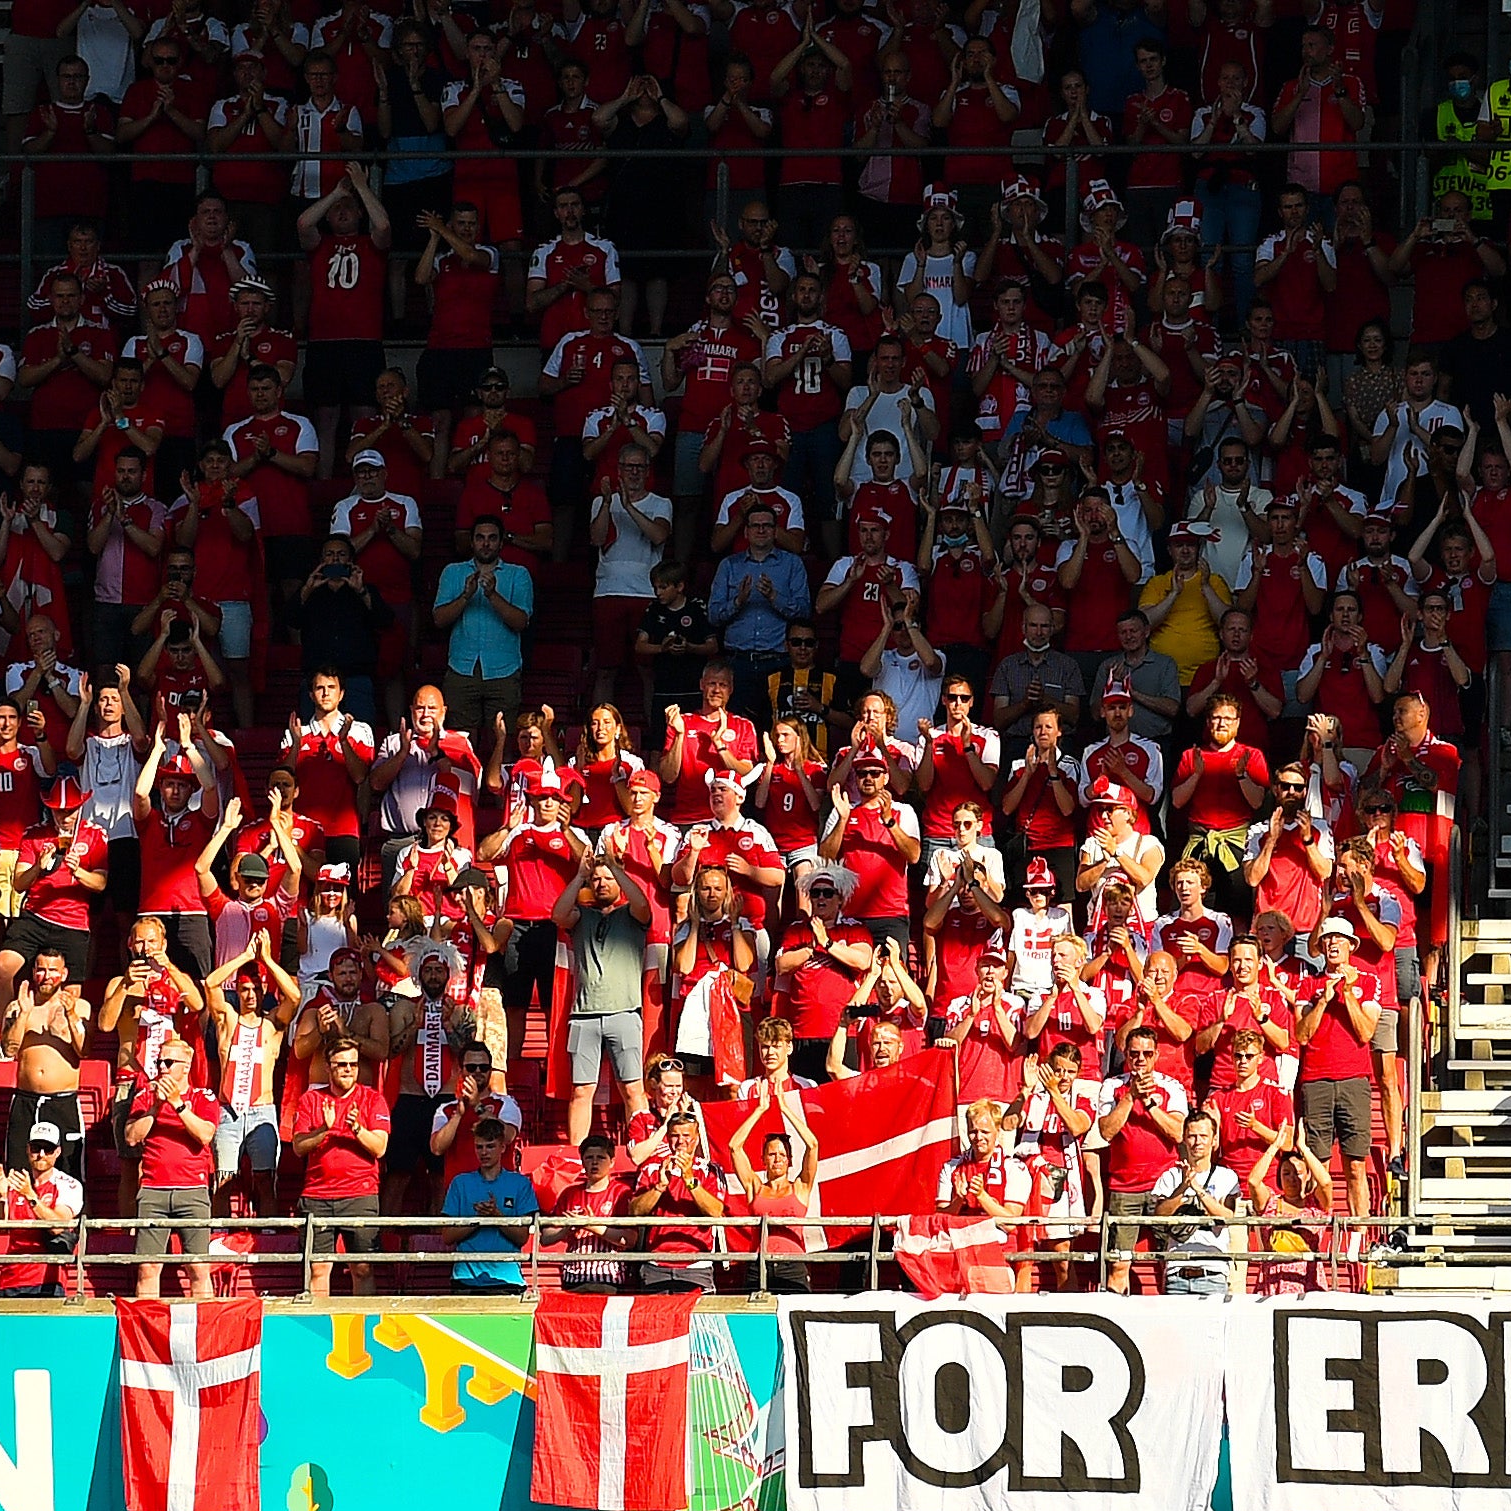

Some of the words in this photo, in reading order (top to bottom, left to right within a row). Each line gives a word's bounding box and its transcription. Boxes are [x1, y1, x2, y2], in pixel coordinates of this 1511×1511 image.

[328, 252, 359, 289] 10
[592, 352, 602, 368] 4
[702, 343, 738, 359] NMARK
[794, 357, 822, 394] 10
[863, 583, 880, 602] 23
[783, 792, 794, 811] 9
[979, 1018, 991, 1036] 9
[1058, 1011, 1072, 1031] 10
[790, 1309, 1146, 1494] FOR
